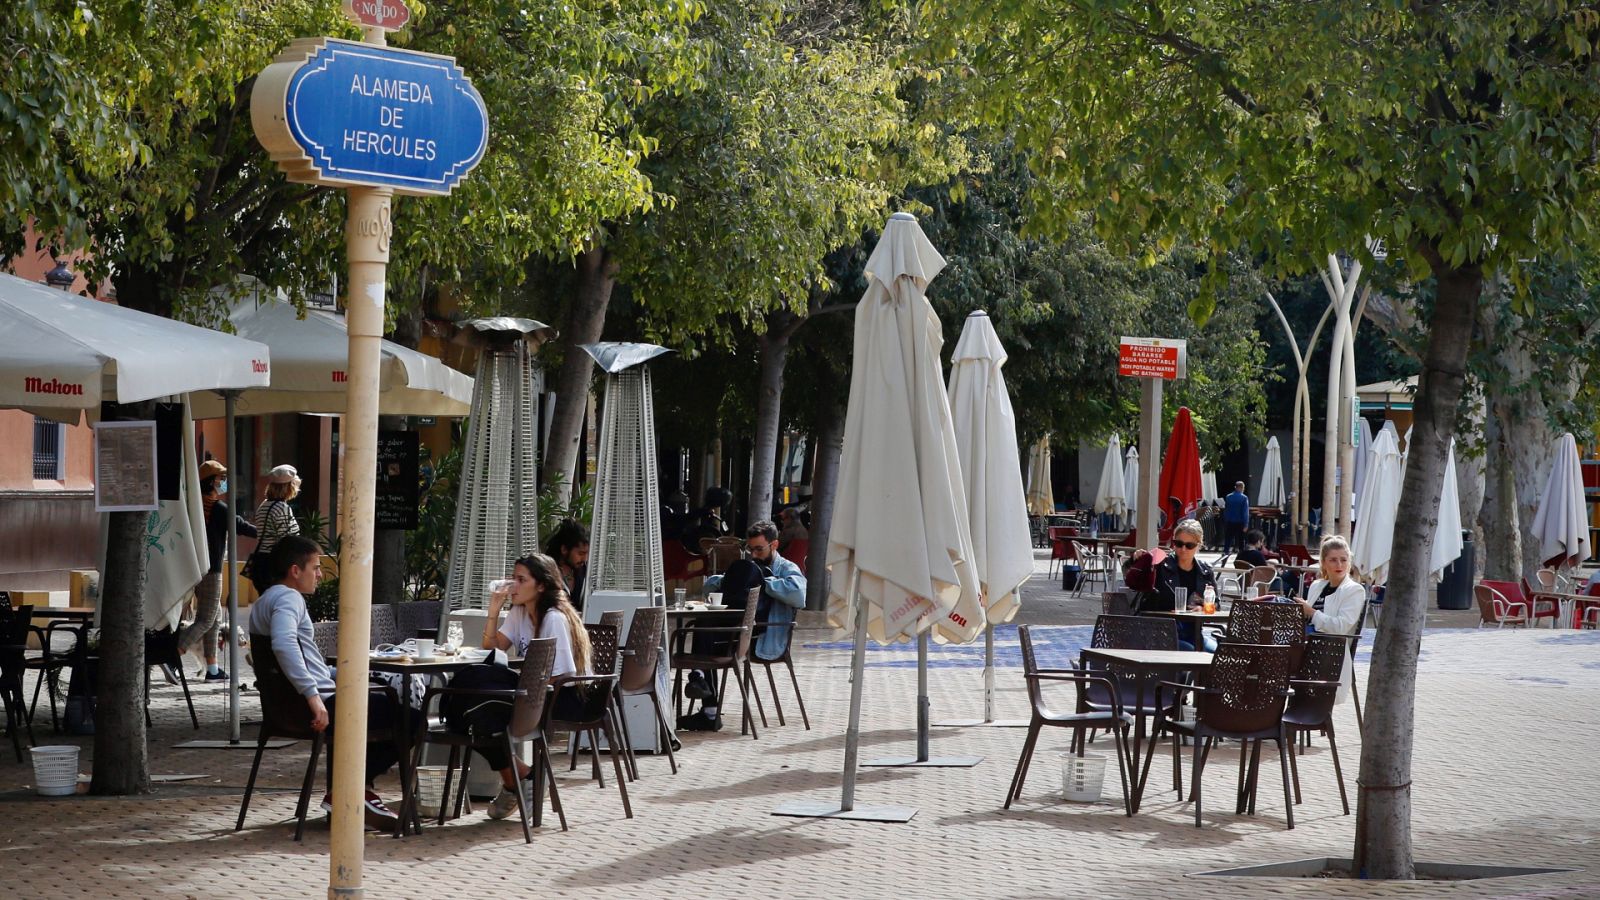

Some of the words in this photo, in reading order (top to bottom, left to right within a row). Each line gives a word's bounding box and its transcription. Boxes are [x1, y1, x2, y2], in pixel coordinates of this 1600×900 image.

[350, 74, 433, 104] ALAMEDA
[380, 106, 403, 128] DE
[343, 129, 436, 161] HERCULES
[1148, 358, 1176, 366] POTABLE
[25, 377, 83, 395] Mahou
